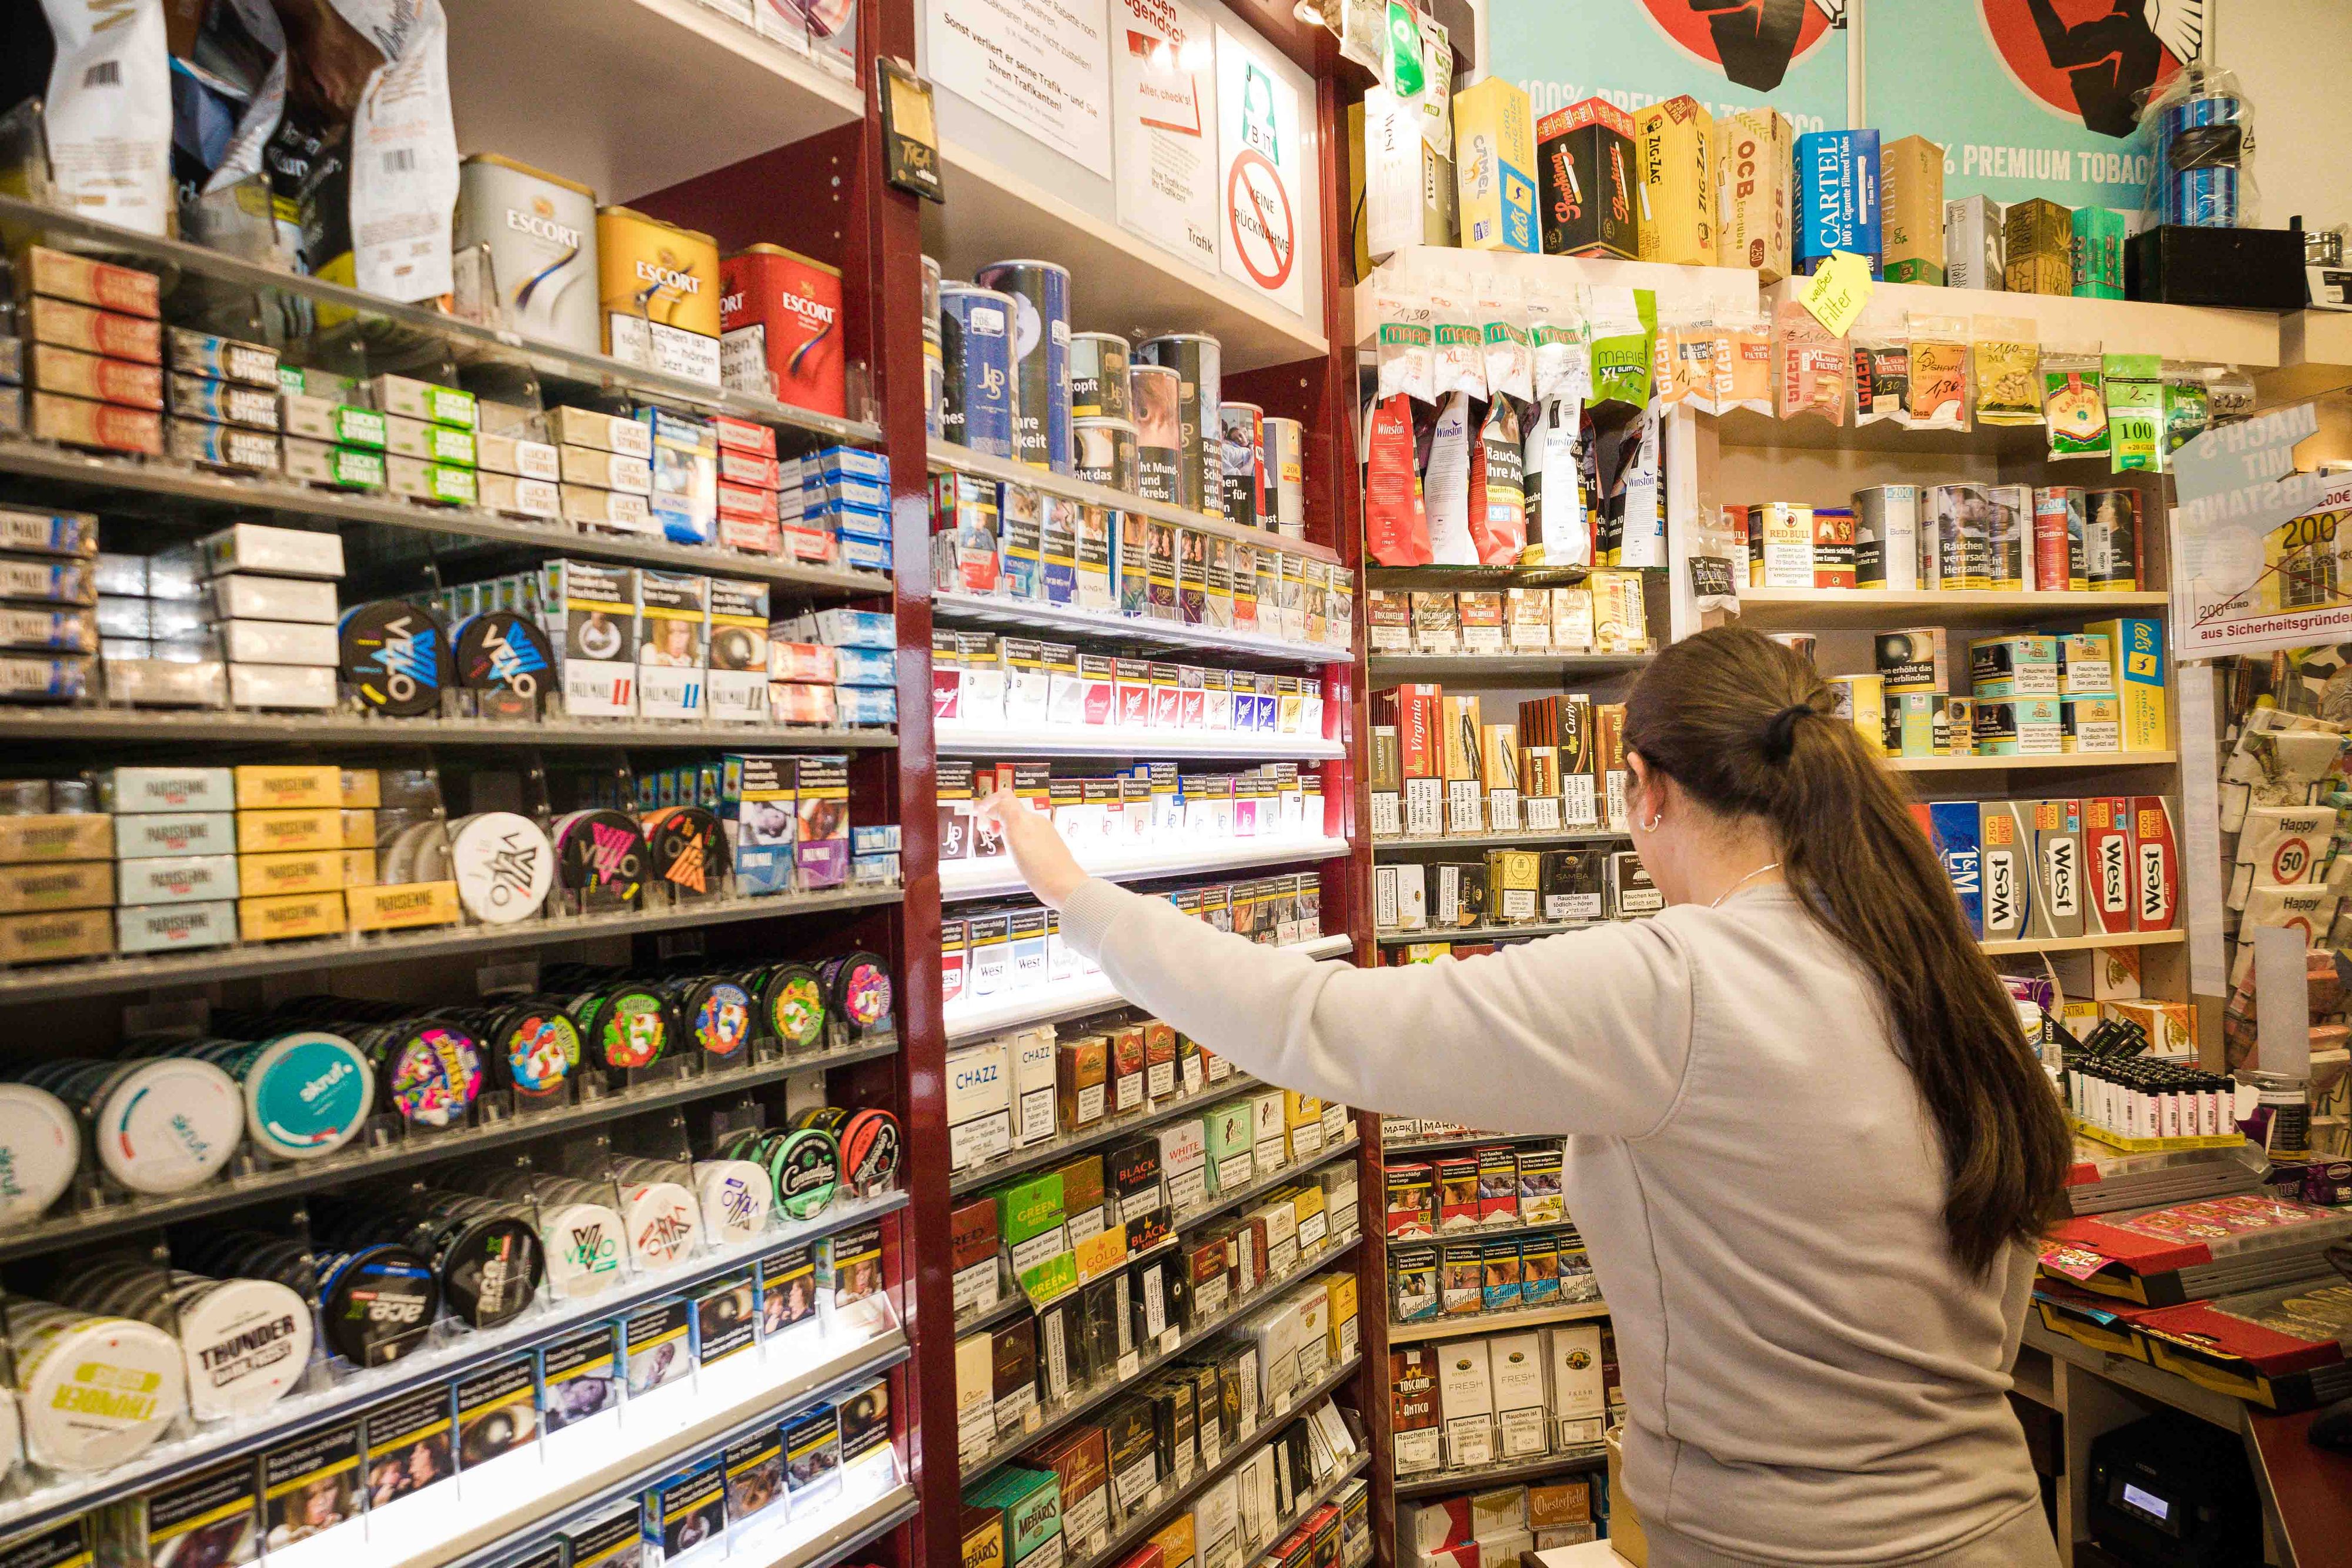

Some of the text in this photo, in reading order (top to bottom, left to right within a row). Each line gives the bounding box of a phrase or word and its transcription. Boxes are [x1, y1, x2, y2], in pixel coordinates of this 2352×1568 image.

[944, 12, 970, 38] Sonst
[972, 30, 1003, 58] verliert
[1015, 59, 1037, 80] seine
[1038, 72, 1062, 96] Trafik
[1070, 93, 1084, 110] und
[1085, 103, 1097, 118] Sie
[988, 58, 1011, 82] Ihren
[1013, 75, 1063, 113] Trafikanten!
[1140, 82, 1192, 106] Alter, check's!
[1673, 99, 1686, 114] 250
[1383, 113, 1395, 152] West
[1473, 135, 1491, 200] CAMEL
[1649, 135, 1663, 185] ZIG-ZAG
[1736, 141, 1756, 199] OCB
[1963, 144, 2070, 181] PREMIUM
[1426, 155, 1435, 200] West
[1697, 130, 1708, 216] ZIG-ZAG
[1840, 136, 1854, 220] Cigarette Filtered Tubes
[1551, 151, 1582, 223] Smoking
[1609, 146, 1629, 225] Smoking
[1818, 136, 1841, 249] CARTEL
[1881, 148, 1896, 230] CARTEL
[1250, 186, 1275, 214] KEINE
[506, 209, 583, 249] ESCORT
[1775, 189, 1784, 252] OCB
[1187, 228, 1214, 255] Trafik
[1234, 208, 1289, 255] RÜCKNAHME
[1751, 244, 1763, 262] x250
[635, 260, 702, 295] ESCORT
[1809, 269, 1833, 303] weißer
[782, 291, 837, 324] ESCORT
[1816, 288, 1852, 329] Filter
[1385, 326, 1431, 346] MARIE
[1440, 326, 1481, 346] MARIE
[1446, 351, 1461, 363] XL
[1598, 349, 1645, 363] MARIE
[1682, 351, 1708, 359] FILTER
[1715, 337, 1733, 394] GIZEH
[1809, 349, 1825, 362] XL
[1874, 354, 1889, 366] XL
[1602, 366, 1619, 382] XL
[1655, 337, 1673, 395] GIZEH
[1787, 349, 1800, 403] GIZEH
[1816, 362, 1839, 370] FILTER
[1882, 365, 1906, 373] FILTER
[1855, 352, 1872, 407] GIZEH
[1377, 422, 1405, 436] Winston
[1436, 425, 1462, 439] Winston
[2122, 422, 2151, 440] 100
[1486, 446, 1522, 467] Rauchen
[1152, 463, 1179, 476] Mund-
[1486, 464, 1507, 477] Ihre
[1141, 475, 1161, 486] und
[1204, 483, 1219, 495] und
[1629, 475, 1655, 488] Winston
[1232, 487, 1247, 501] für
[1769, 529, 1810, 539] RED BULL
[2281, 513, 2337, 551] 200
[1943, 541, 1983, 551] Rauchen
[1824, 555, 1842, 563] Lunge
[1374, 610, 1404, 621] TOSCANELLO
[1420, 610, 1451, 621] TOSCANELLO
[1468, 609, 1495, 619] TOSCANELLO
[2199, 600, 2249, 619] 200 EURO
[2201, 611, 2352, 640] aus Sicherheitsgründe
[385, 616, 416, 701] VELO
[482, 623, 537, 698] VELO
[1892, 664, 1932, 674] erhöht das
[1893, 674, 1930, 683] erblinden
[1411, 698, 1425, 751] Virginia
[1565, 701, 1578, 734] Curly
[1988, 820, 1997, 842] 250
[2280, 818, 2318, 833] Happy
[1948, 848, 1980, 894] L&M
[2280, 851, 2302, 872] 50
[1555, 872, 1589, 881] SAMBA
[2054, 843, 2071, 909] West
[2105, 840, 2122, 906] West
[2144, 850, 2161, 917] West
[1991, 857, 2009, 925] West
[2283, 897, 2321, 911] Happy
[981, 964, 1003, 977] West
[1018, 956, 1041, 969] West
[2063, 1005, 2085, 1017] EXTRA
[2045, 1021, 2053, 1042] CLICK
[1022, 1045, 1051, 1064] CHAZZ
[956, 1064, 998, 1090] CHAZZ
[1169, 1141, 1200, 1161] WHITE
[1177, 1154, 1192, 1165] MINI
[1119, 1158, 1156, 1182] BLACK
[1017, 1199, 1057, 1222] GREEN
[1027, 1215, 1047, 1228] MINI
[1130, 1223, 1167, 1246] BLACK
[1141, 1236, 1159, 1251] MINI
[1086, 1246, 1118, 1268] GOLD
[1416, 1255, 1434, 1263] verstopft
[1030, 1272, 1067, 1298] GREEN
[1560, 1272, 1596, 1299] Chesterfield
[1399, 1293, 1436, 1319] Chesterfield
[1444, 1286, 1481, 1311] Chesterfield
[368, 1299, 426, 1323] ace
[198, 1314, 296, 1371] THUNDER
[1400, 1377, 1430, 1393] TOSCANO
[1448, 1380, 1484, 1392] FRESH
[1501, 1372, 1536, 1383] FRESH
[1568, 1389, 1594, 1398] FRESH
[1404, 1402, 1429, 1417] ANTICO
[1506, 1412, 1529, 1420] Rauchen
[1453, 1417, 1486, 1429] Rauchen ist
[1398, 1428, 1436, 1442] Rauchen ist
[1534, 1487, 1585, 1516] Chesterfield
